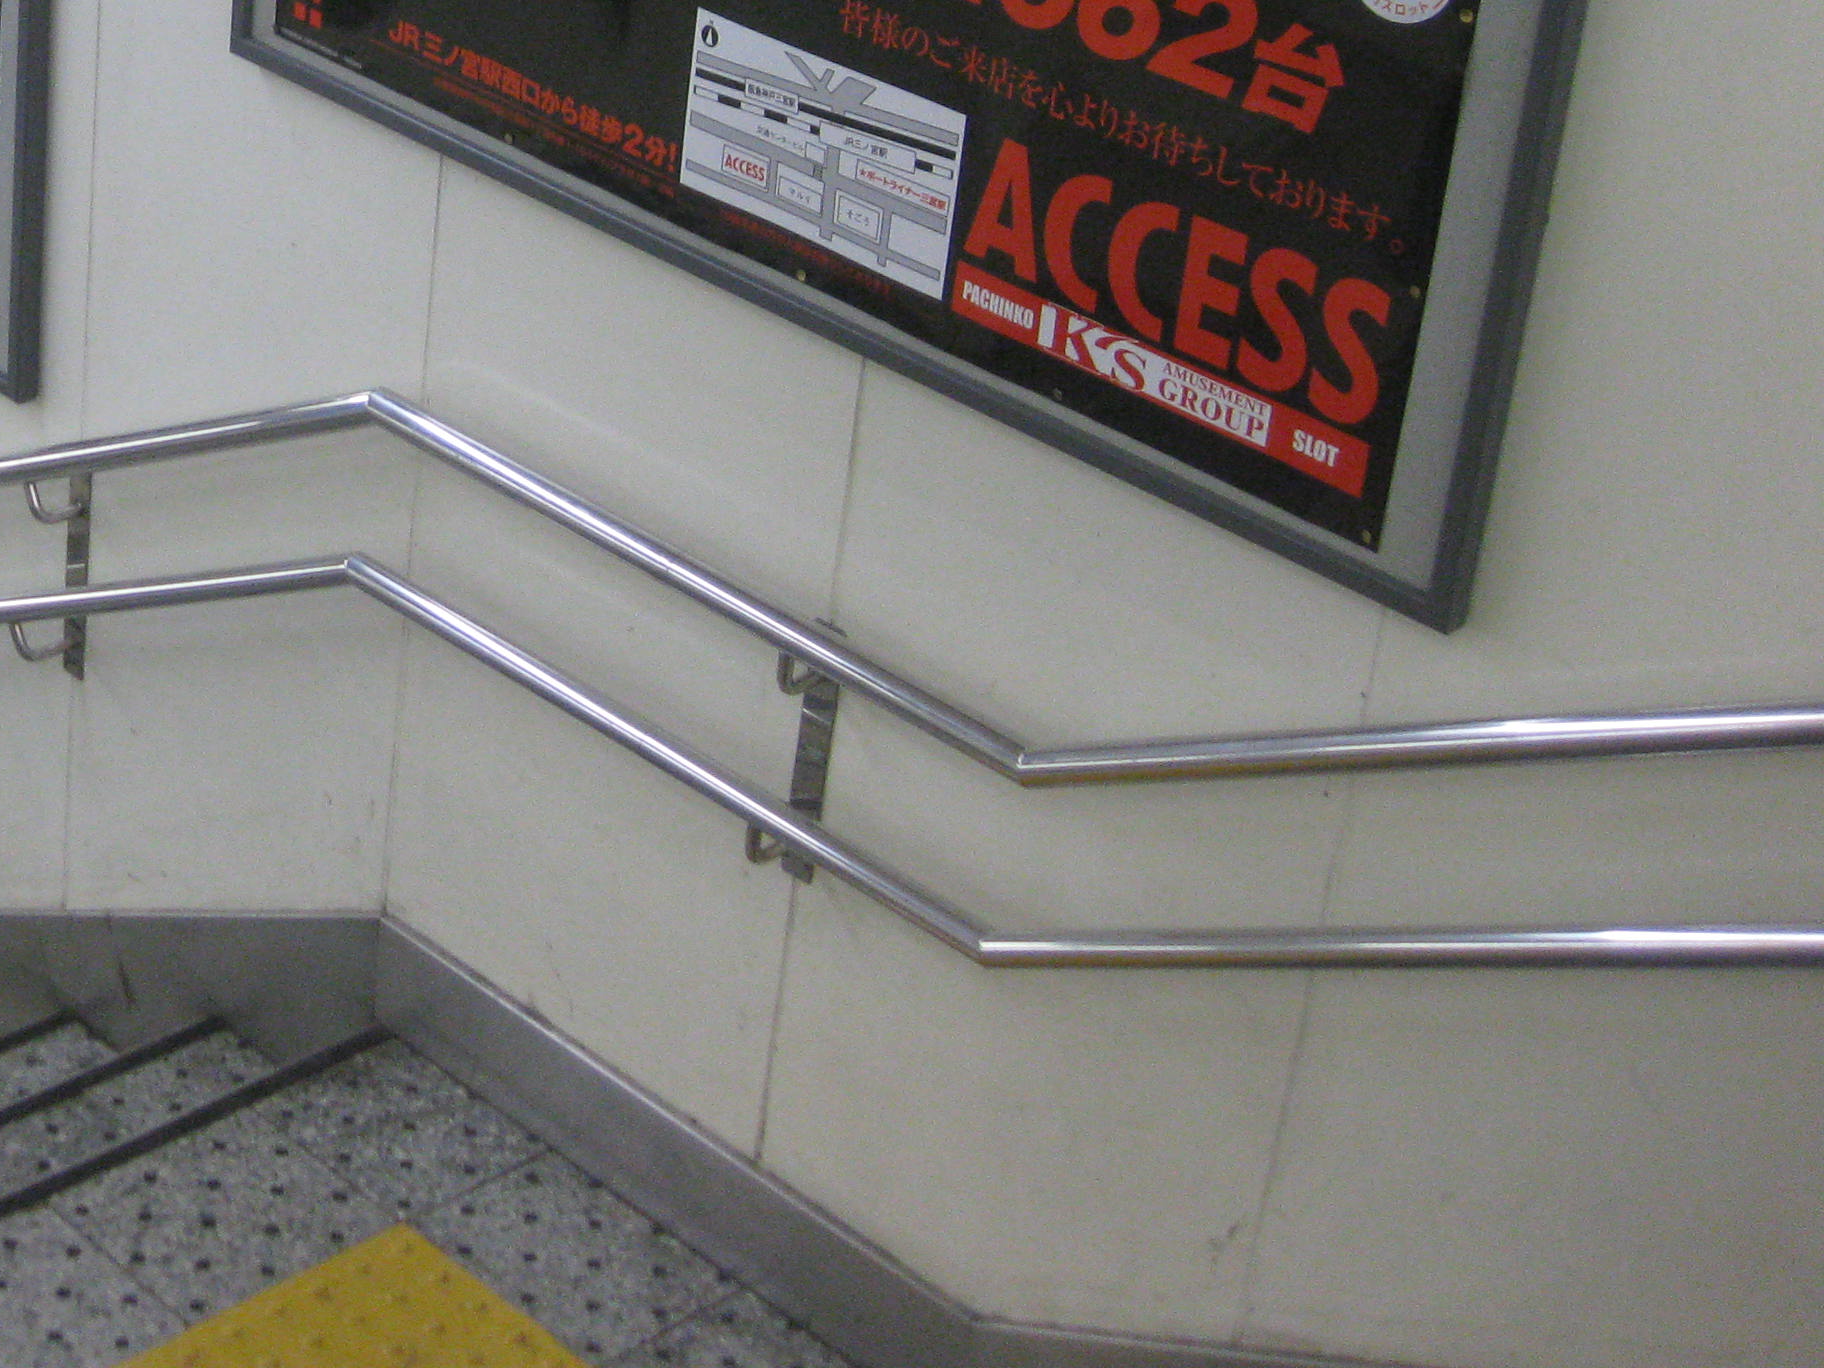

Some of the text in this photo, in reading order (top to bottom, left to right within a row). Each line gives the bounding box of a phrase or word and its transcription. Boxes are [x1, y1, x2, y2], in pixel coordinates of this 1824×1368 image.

[723, 152, 767, 183] ACCESS
[962, 280, 1035, 329] PACHINKO
[963, 137, 1392, 426] ACCESS
[1158, 378, 1265, 441] GROUP
[1162, 361, 1267, 417] AMUSEMENT
[1292, 429, 1340, 468] SLOT
